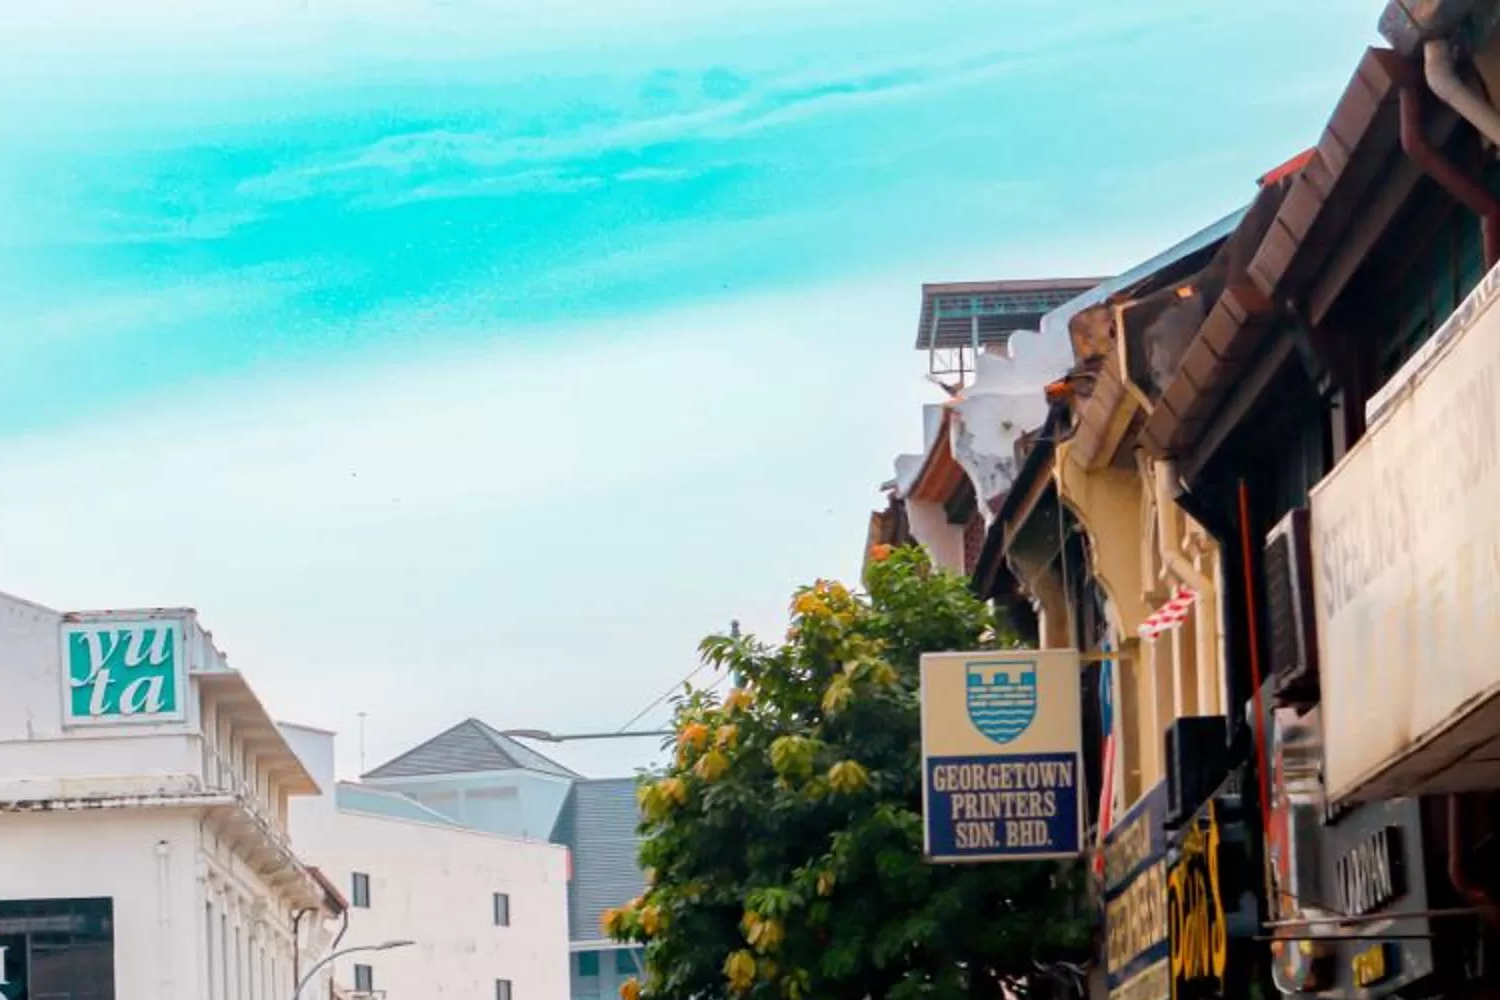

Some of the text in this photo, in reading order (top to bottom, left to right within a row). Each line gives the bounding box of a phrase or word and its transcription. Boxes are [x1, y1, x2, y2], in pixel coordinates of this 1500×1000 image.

[67, 627, 171, 687] yu
[89, 668, 165, 714] ta
[933, 762, 1073, 792] GEORGETOWN
[952, 791, 1056, 820] PRINTERS
[955, 819, 1053, 849] SDN. BHD.
